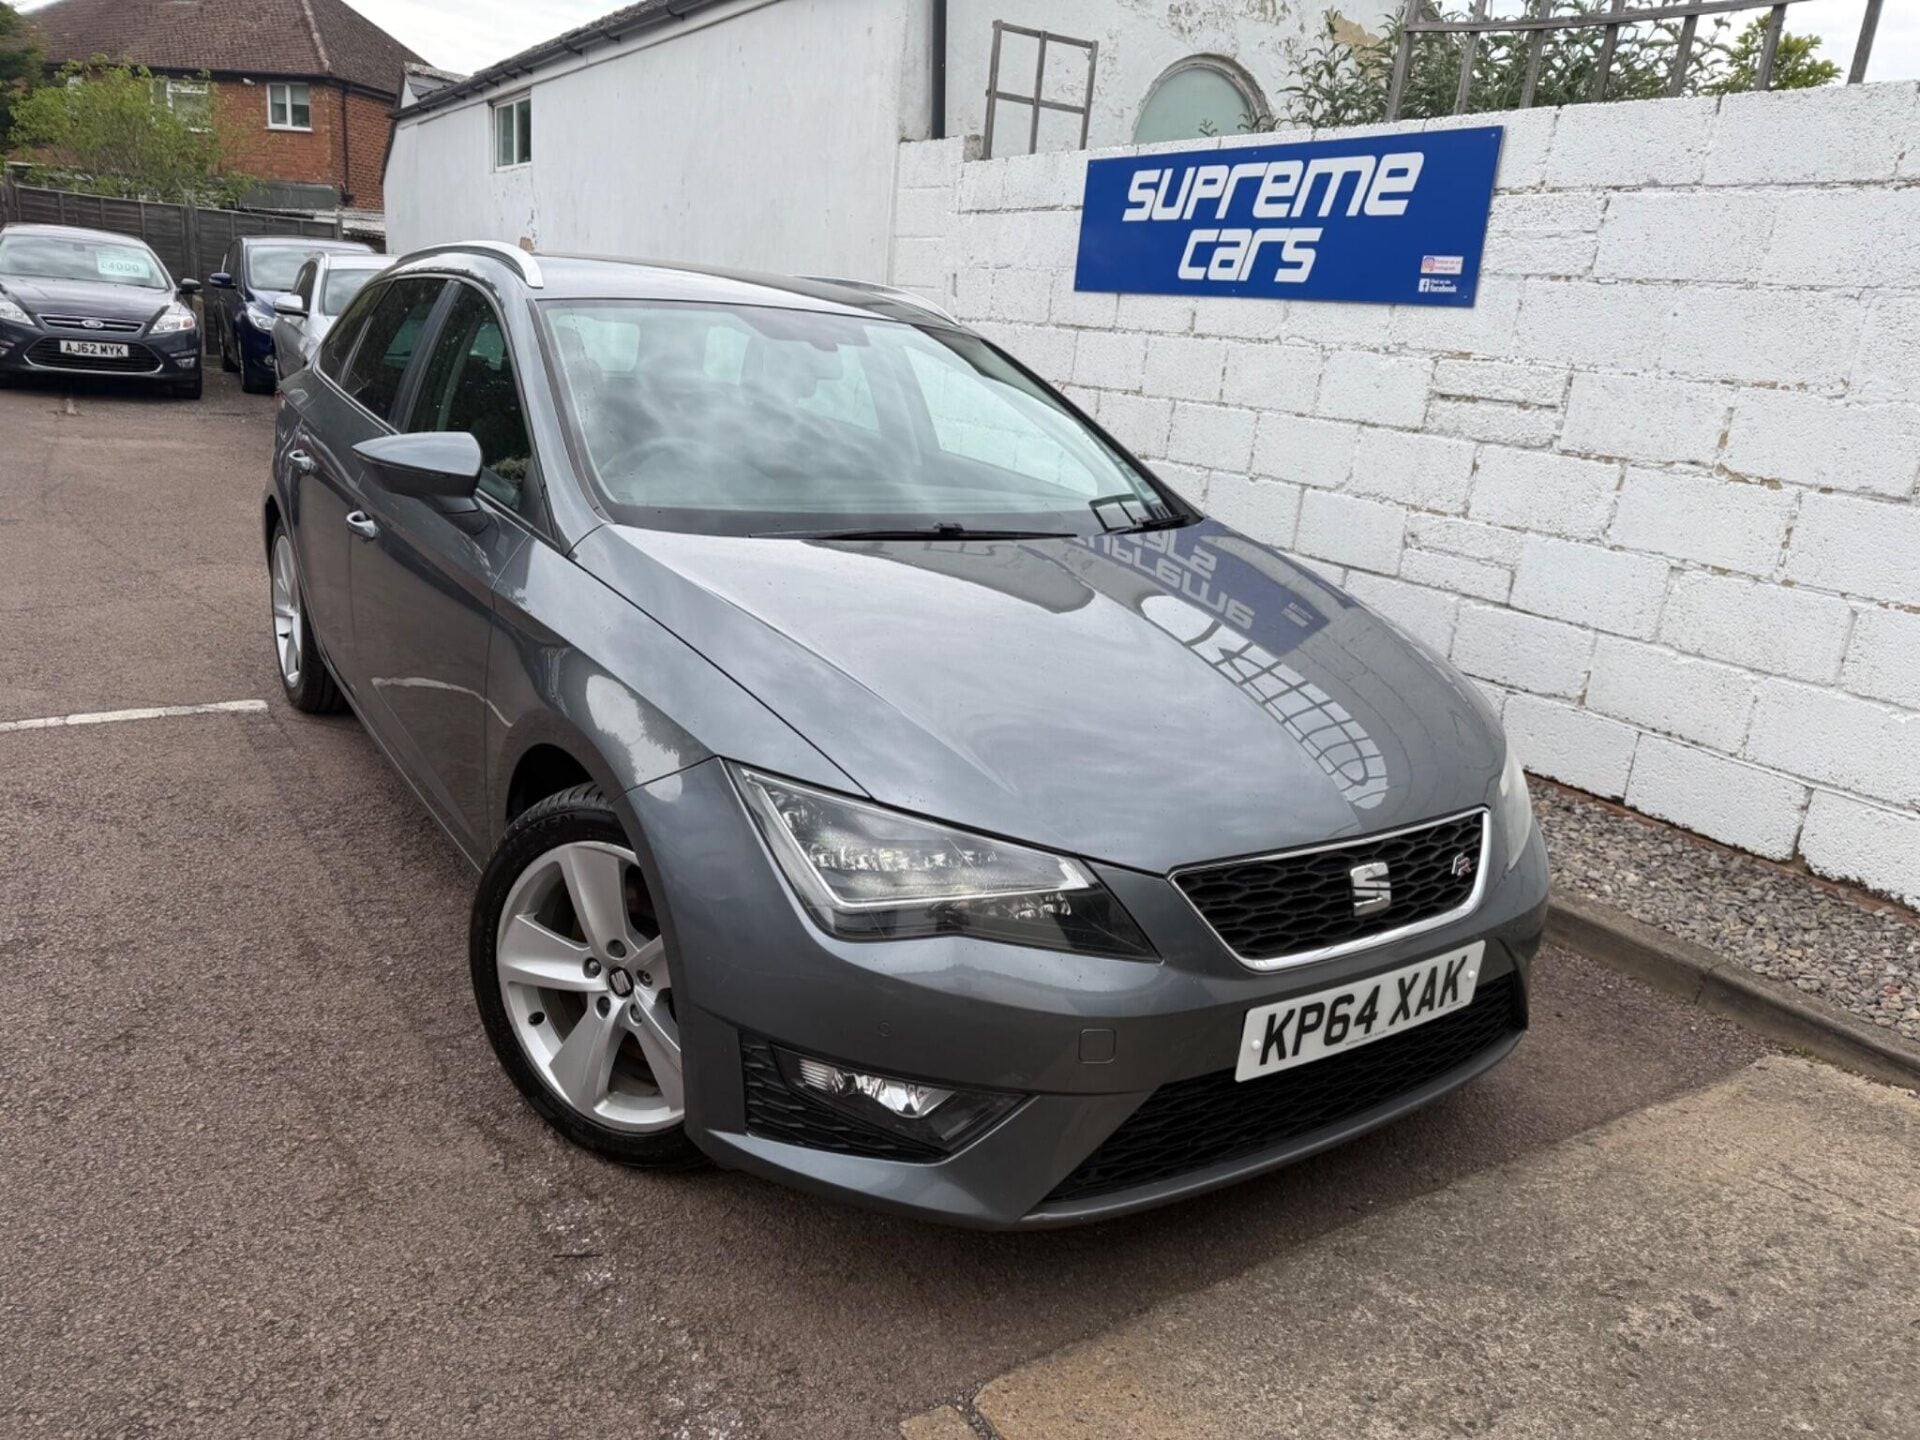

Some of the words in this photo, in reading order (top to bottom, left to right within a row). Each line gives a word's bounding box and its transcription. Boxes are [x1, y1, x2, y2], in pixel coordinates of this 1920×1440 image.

[66, 342, 97, 355] AJ62
[100, 344, 123, 356] MYK
[1259, 984, 1381, 1066] KP64
[1388, 955, 1468, 1027] XAK
